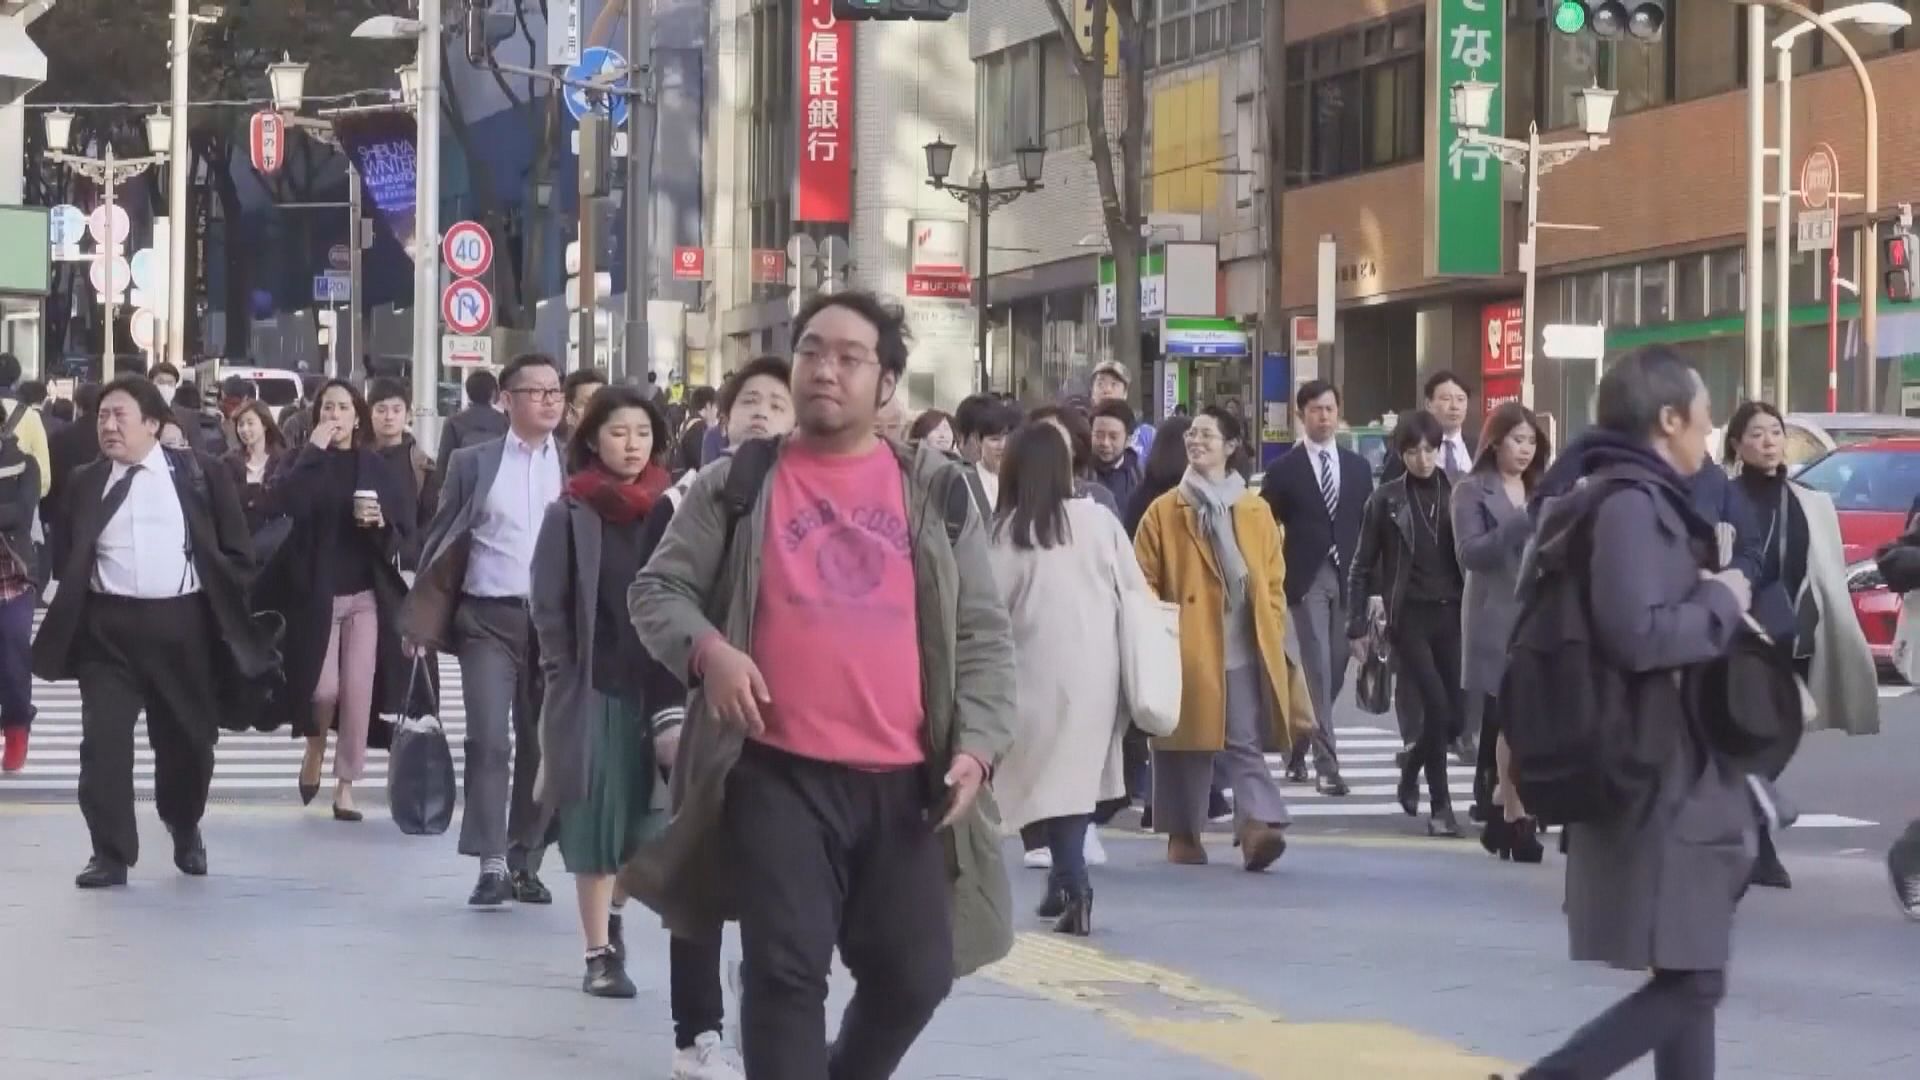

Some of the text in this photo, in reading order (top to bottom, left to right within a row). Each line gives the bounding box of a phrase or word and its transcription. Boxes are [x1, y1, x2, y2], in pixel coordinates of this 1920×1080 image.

[808, 0, 840, 162] J信託銀行
[1449, 0, 1493, 182] な行
[456, 238, 481, 262] 40
